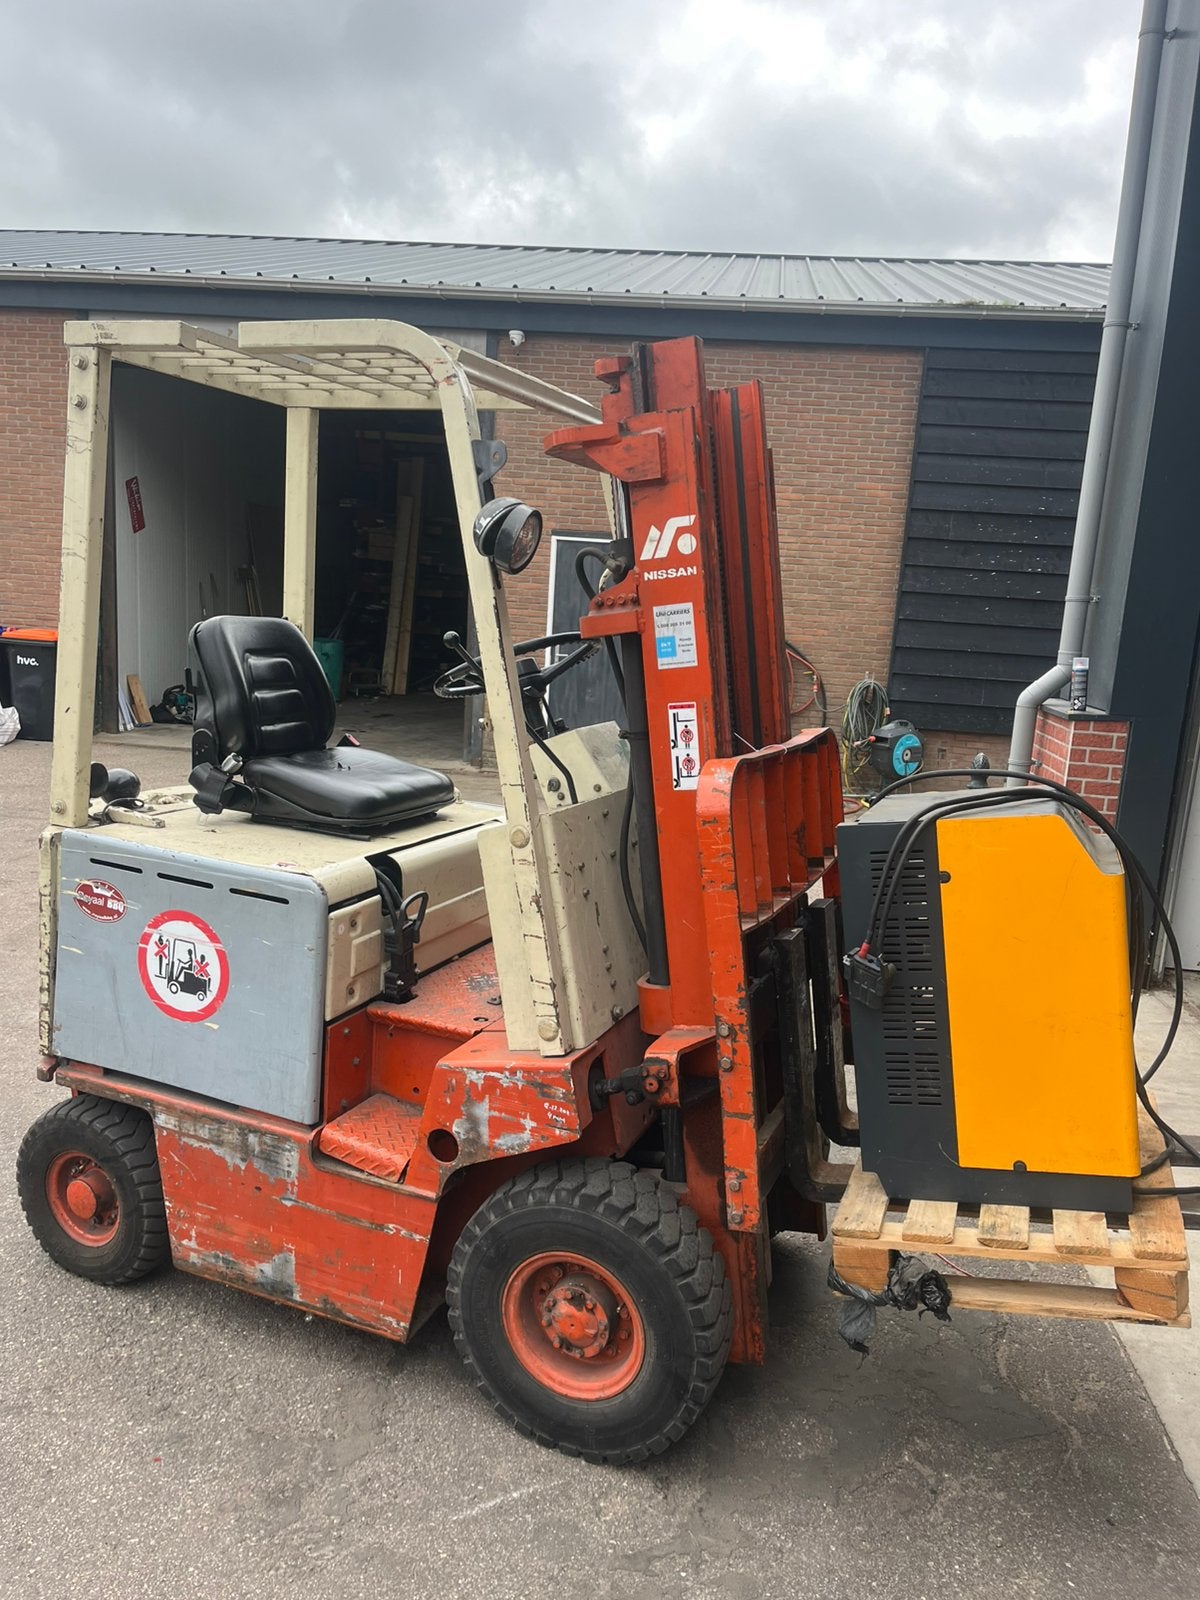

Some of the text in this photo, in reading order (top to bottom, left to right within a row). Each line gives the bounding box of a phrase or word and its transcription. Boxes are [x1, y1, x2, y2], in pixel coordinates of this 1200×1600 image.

[644, 566, 697, 581] NISSAN
[17, 655, 39, 666] hvc.
[106, 898, 124, 913] BBQ
